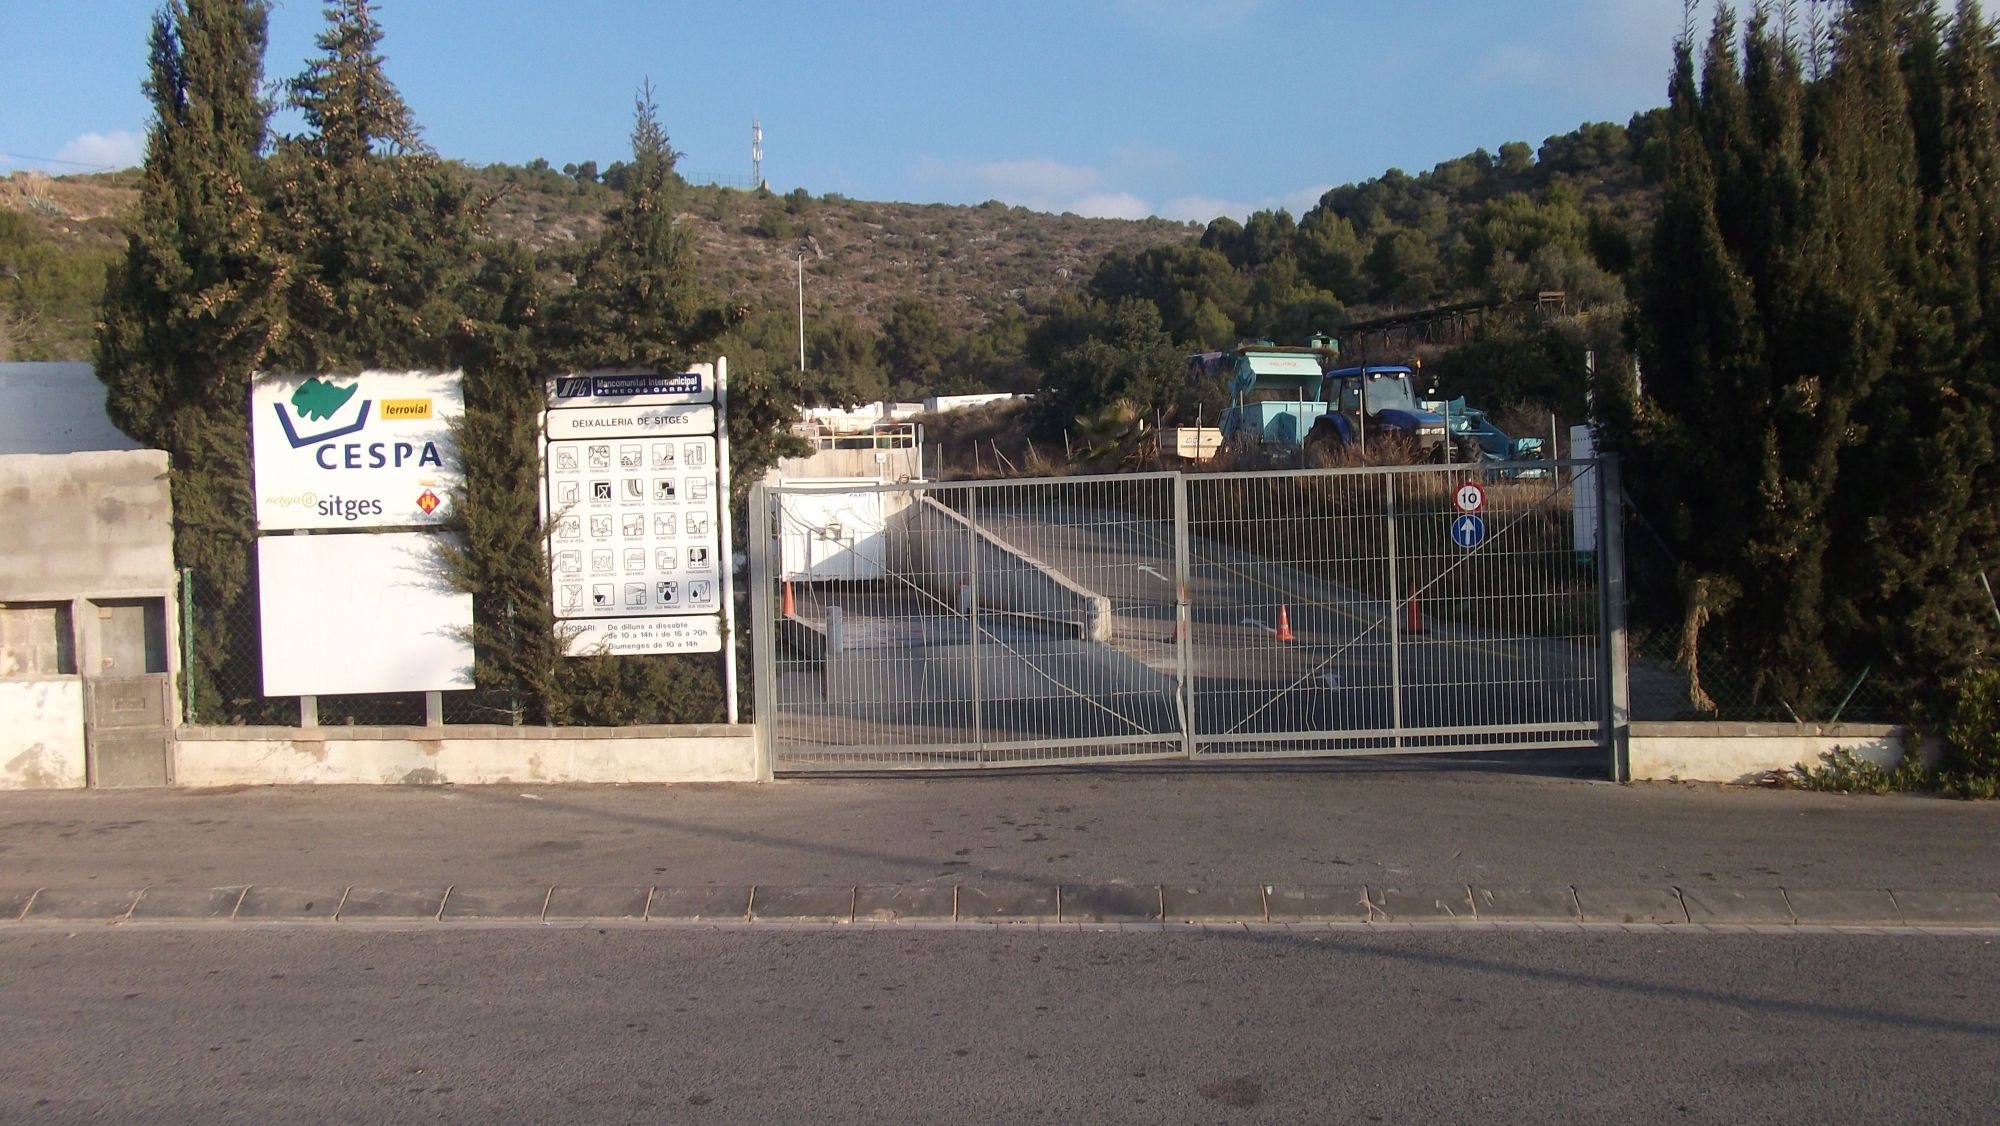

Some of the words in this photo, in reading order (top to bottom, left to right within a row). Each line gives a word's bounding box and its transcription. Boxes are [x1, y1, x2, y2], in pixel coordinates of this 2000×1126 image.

[596, 378, 646, 388] Mancomunitat
[386, 403, 428, 415] ferrovial
[572, 418, 634, 428] DEIXALLERIA
[637, 416, 650, 426] DE
[655, 415, 689, 425] SITGES
[316, 441, 442, 470] CESPA
[1462, 493, 1477, 504] 10
[317, 494, 383, 521] sitges
[621, 622, 645, 631] dilluns
[656, 621, 688, 629] dissabte
[693, 629, 708, 637] 20h
[608, 642, 650, 650] Diumenges
